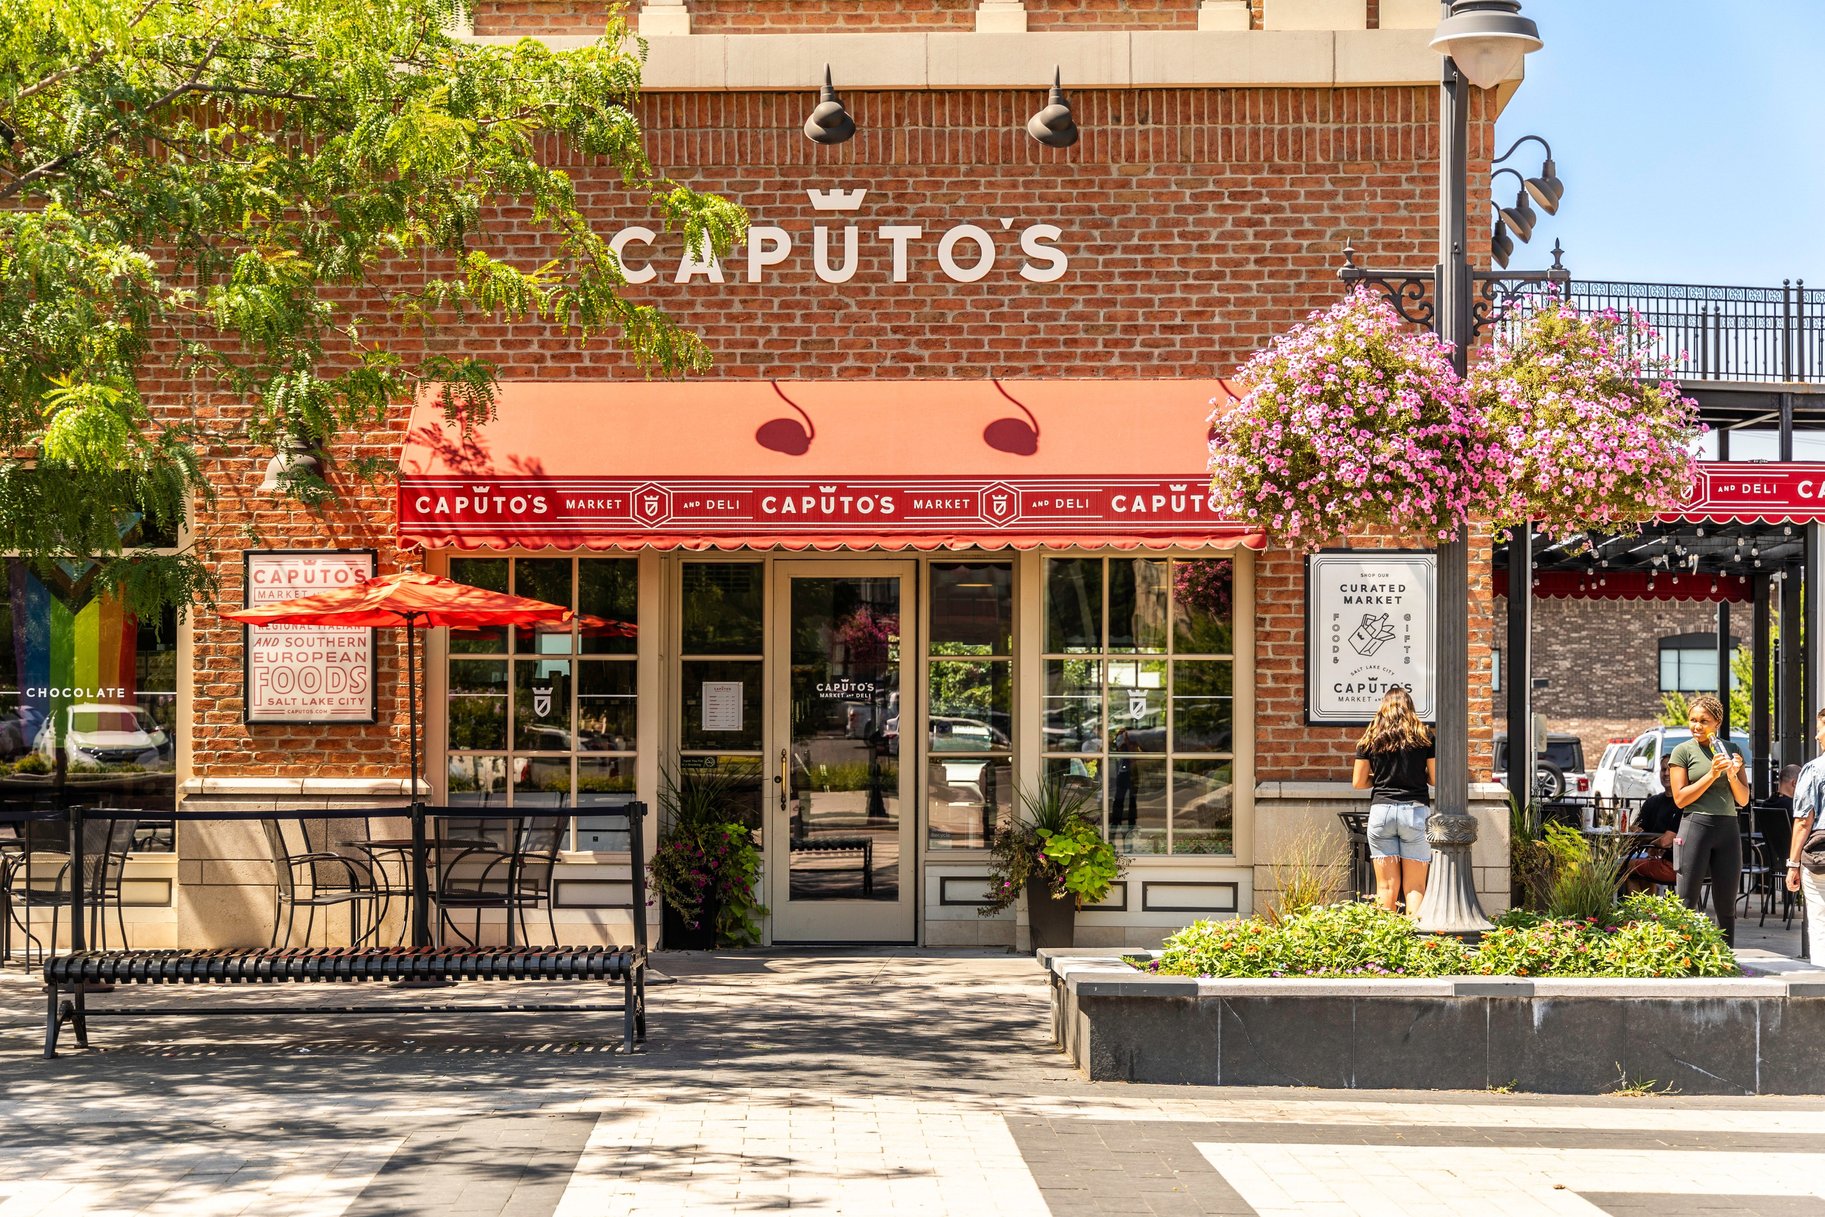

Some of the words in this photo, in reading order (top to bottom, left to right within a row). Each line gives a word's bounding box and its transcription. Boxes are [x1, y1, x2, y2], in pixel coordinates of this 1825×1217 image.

[608, 217, 1069, 284] CAPUTO'S
[1717, 484, 1736, 493] AND
[1742, 483, 1777, 494] DELI
[415, 494, 548, 514] CAPUTO'S
[566, 499, 622, 510] MARKET
[683, 501, 701, 509] AND
[706, 499, 740, 510] DELI
[762, 494, 895, 515] CAPUTO'S
[913, 499, 970, 510] MARKET
[1032, 500, 1049, 508] AND
[1055, 498, 1089, 509] DELI
[1111, 494, 1224, 513] CAPUTO
[253, 567, 366, 584] CAPUTO'S
[1340, 584, 1406, 593] CURATED
[257, 590, 307, 599] MARKET
[1343, 596, 1402, 605] MARKET
[253, 637, 280, 648] AND
[285, 637, 367, 648] SOUTHERN
[1403, 613, 1411, 665] GIFTS
[253, 651, 367, 663] EUROPEAN
[1350, 666, 1363, 676] SALT
[1382, 667, 1395, 676] CITY
[253, 665, 367, 706] FOODS
[816, 682, 875, 692] CAPUTO'S
[1333, 682, 1413, 694] CAPUTO'S
[26, 687, 125, 698] CHOCOLATE
[267, 697, 297, 706] SALT
[302, 697, 334, 706] LAKE
[338, 697, 365, 706] CITY
